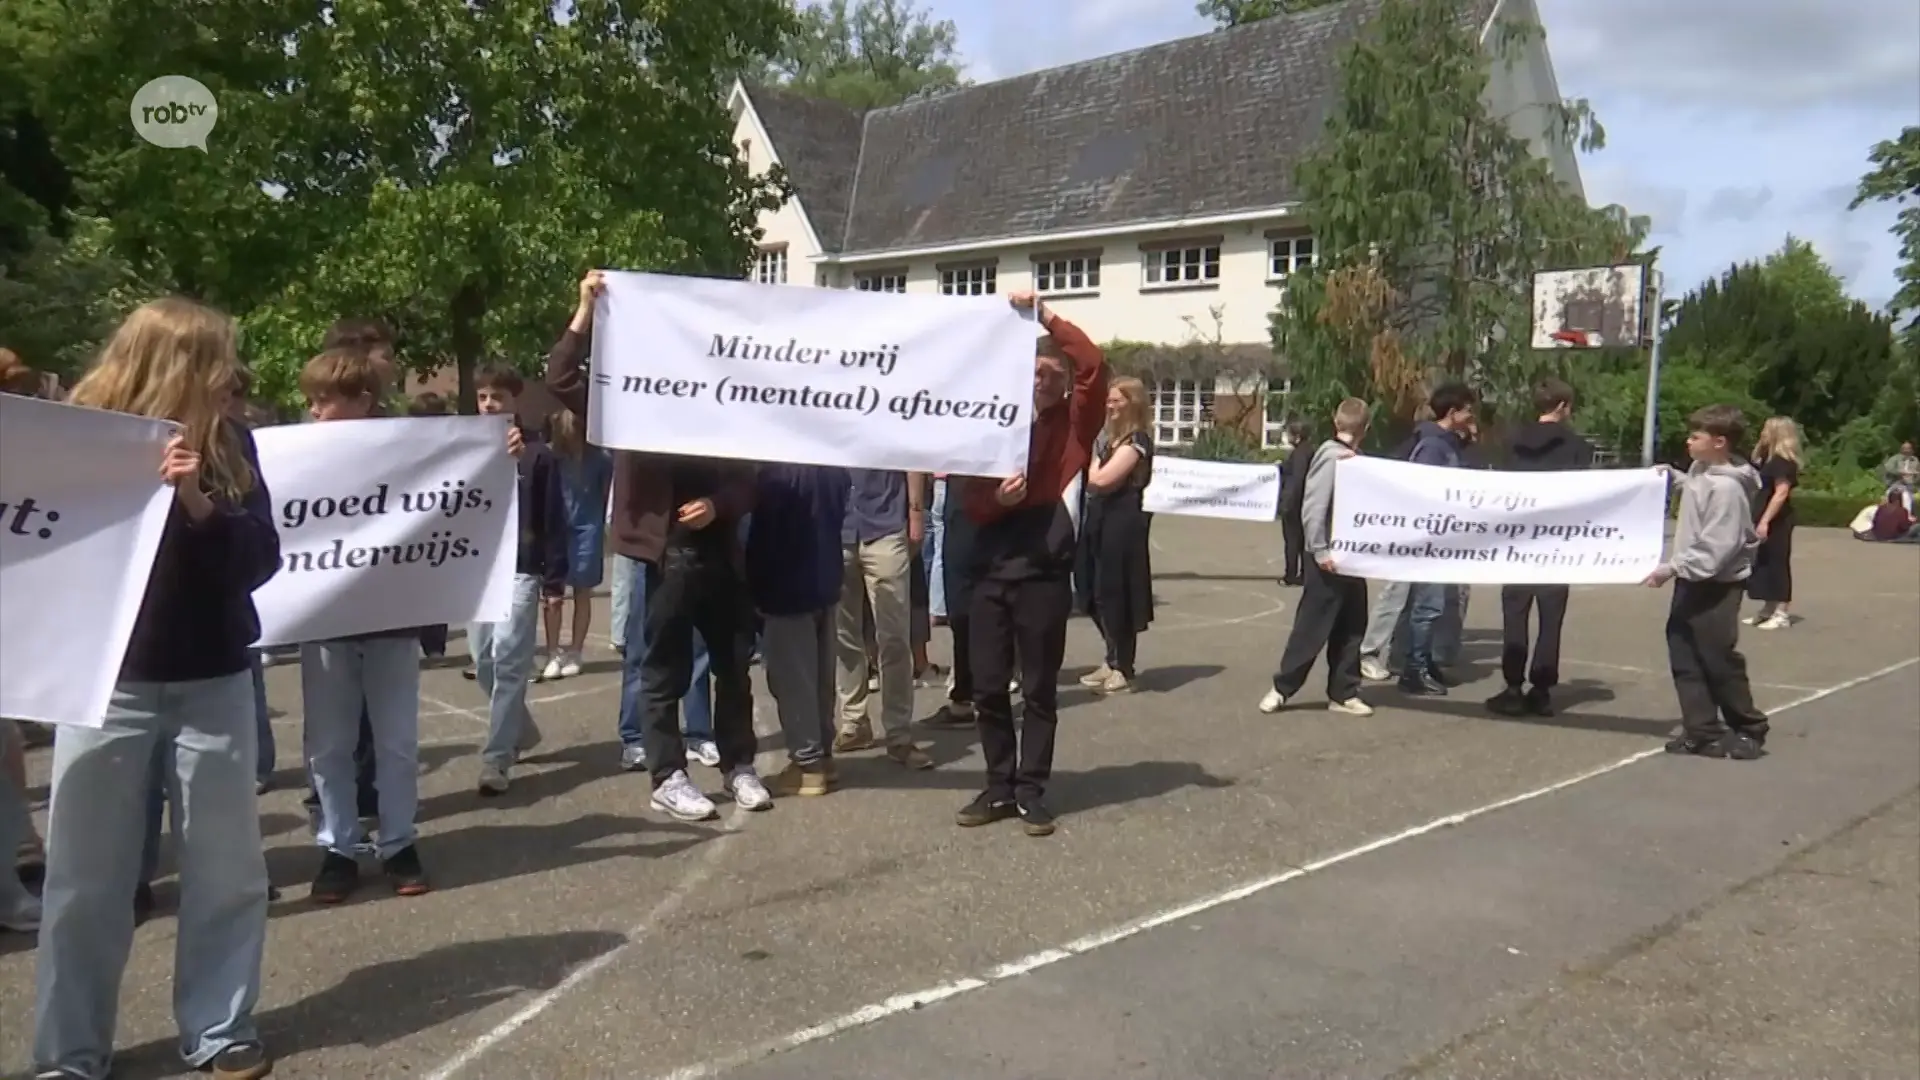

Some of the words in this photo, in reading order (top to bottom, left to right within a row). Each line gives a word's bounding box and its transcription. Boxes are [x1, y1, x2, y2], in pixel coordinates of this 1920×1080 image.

[707, 334, 830, 366] Minder
[841, 344, 900, 375] vrij
[595, 373, 611, 386] =
[622, 376, 707, 398] meer
[715, 376, 880, 415] (mentaal)
[889, 391, 1020, 427] afwezig
[283, 485, 388, 528] goed
[402, 481, 492, 519] wijs,
[1353, 513, 1406, 528] geen
[1414, 513, 1489, 536] cijfers
[1495, 523, 1526, 539] op
[1331, 539, 1382, 555] onze
[1387, 541, 1500, 561] toekomst
[1506, 545, 1584, 567] begint
